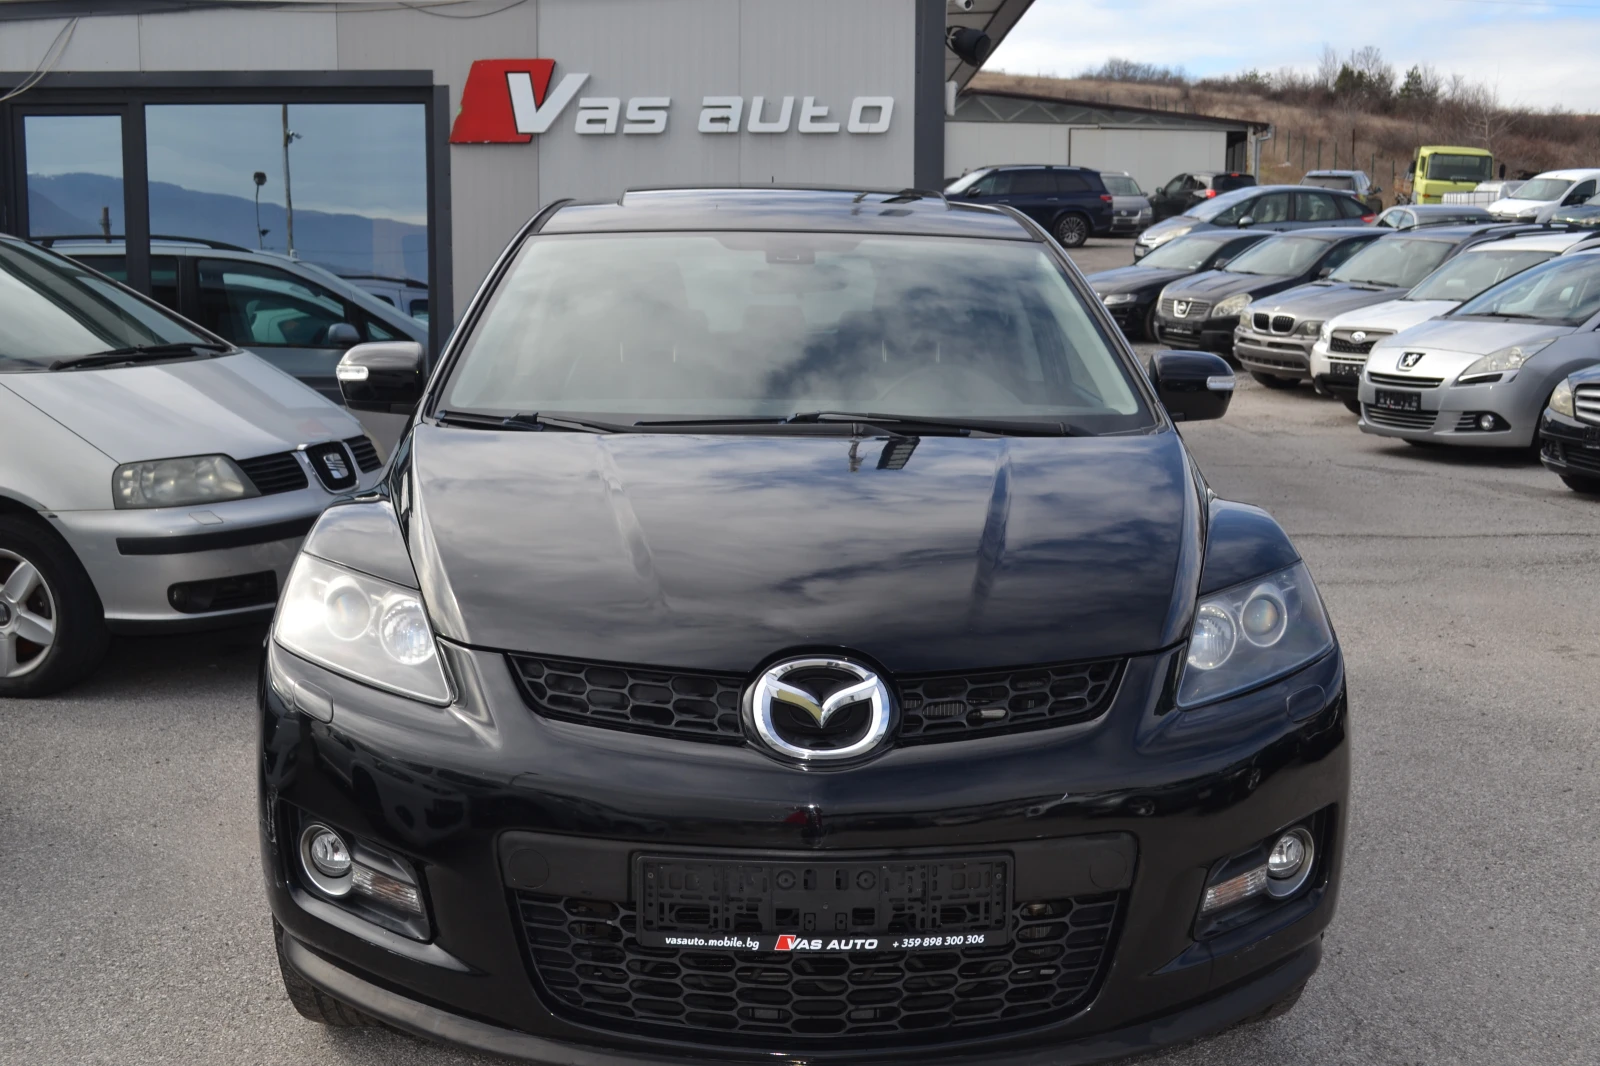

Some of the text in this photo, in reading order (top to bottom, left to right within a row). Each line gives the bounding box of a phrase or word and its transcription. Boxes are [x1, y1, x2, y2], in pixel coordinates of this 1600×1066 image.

[507, 71, 894, 134] Vas auto
[665, 935, 760, 951] vasauto.mobile.bg
[786, 937, 879, 951] VAS AUTO
[901, 937, 921, 948] 359
[922, 936, 942, 947] 898
[944, 935, 964, 946] 300
[965, 934, 985, 944] 306
